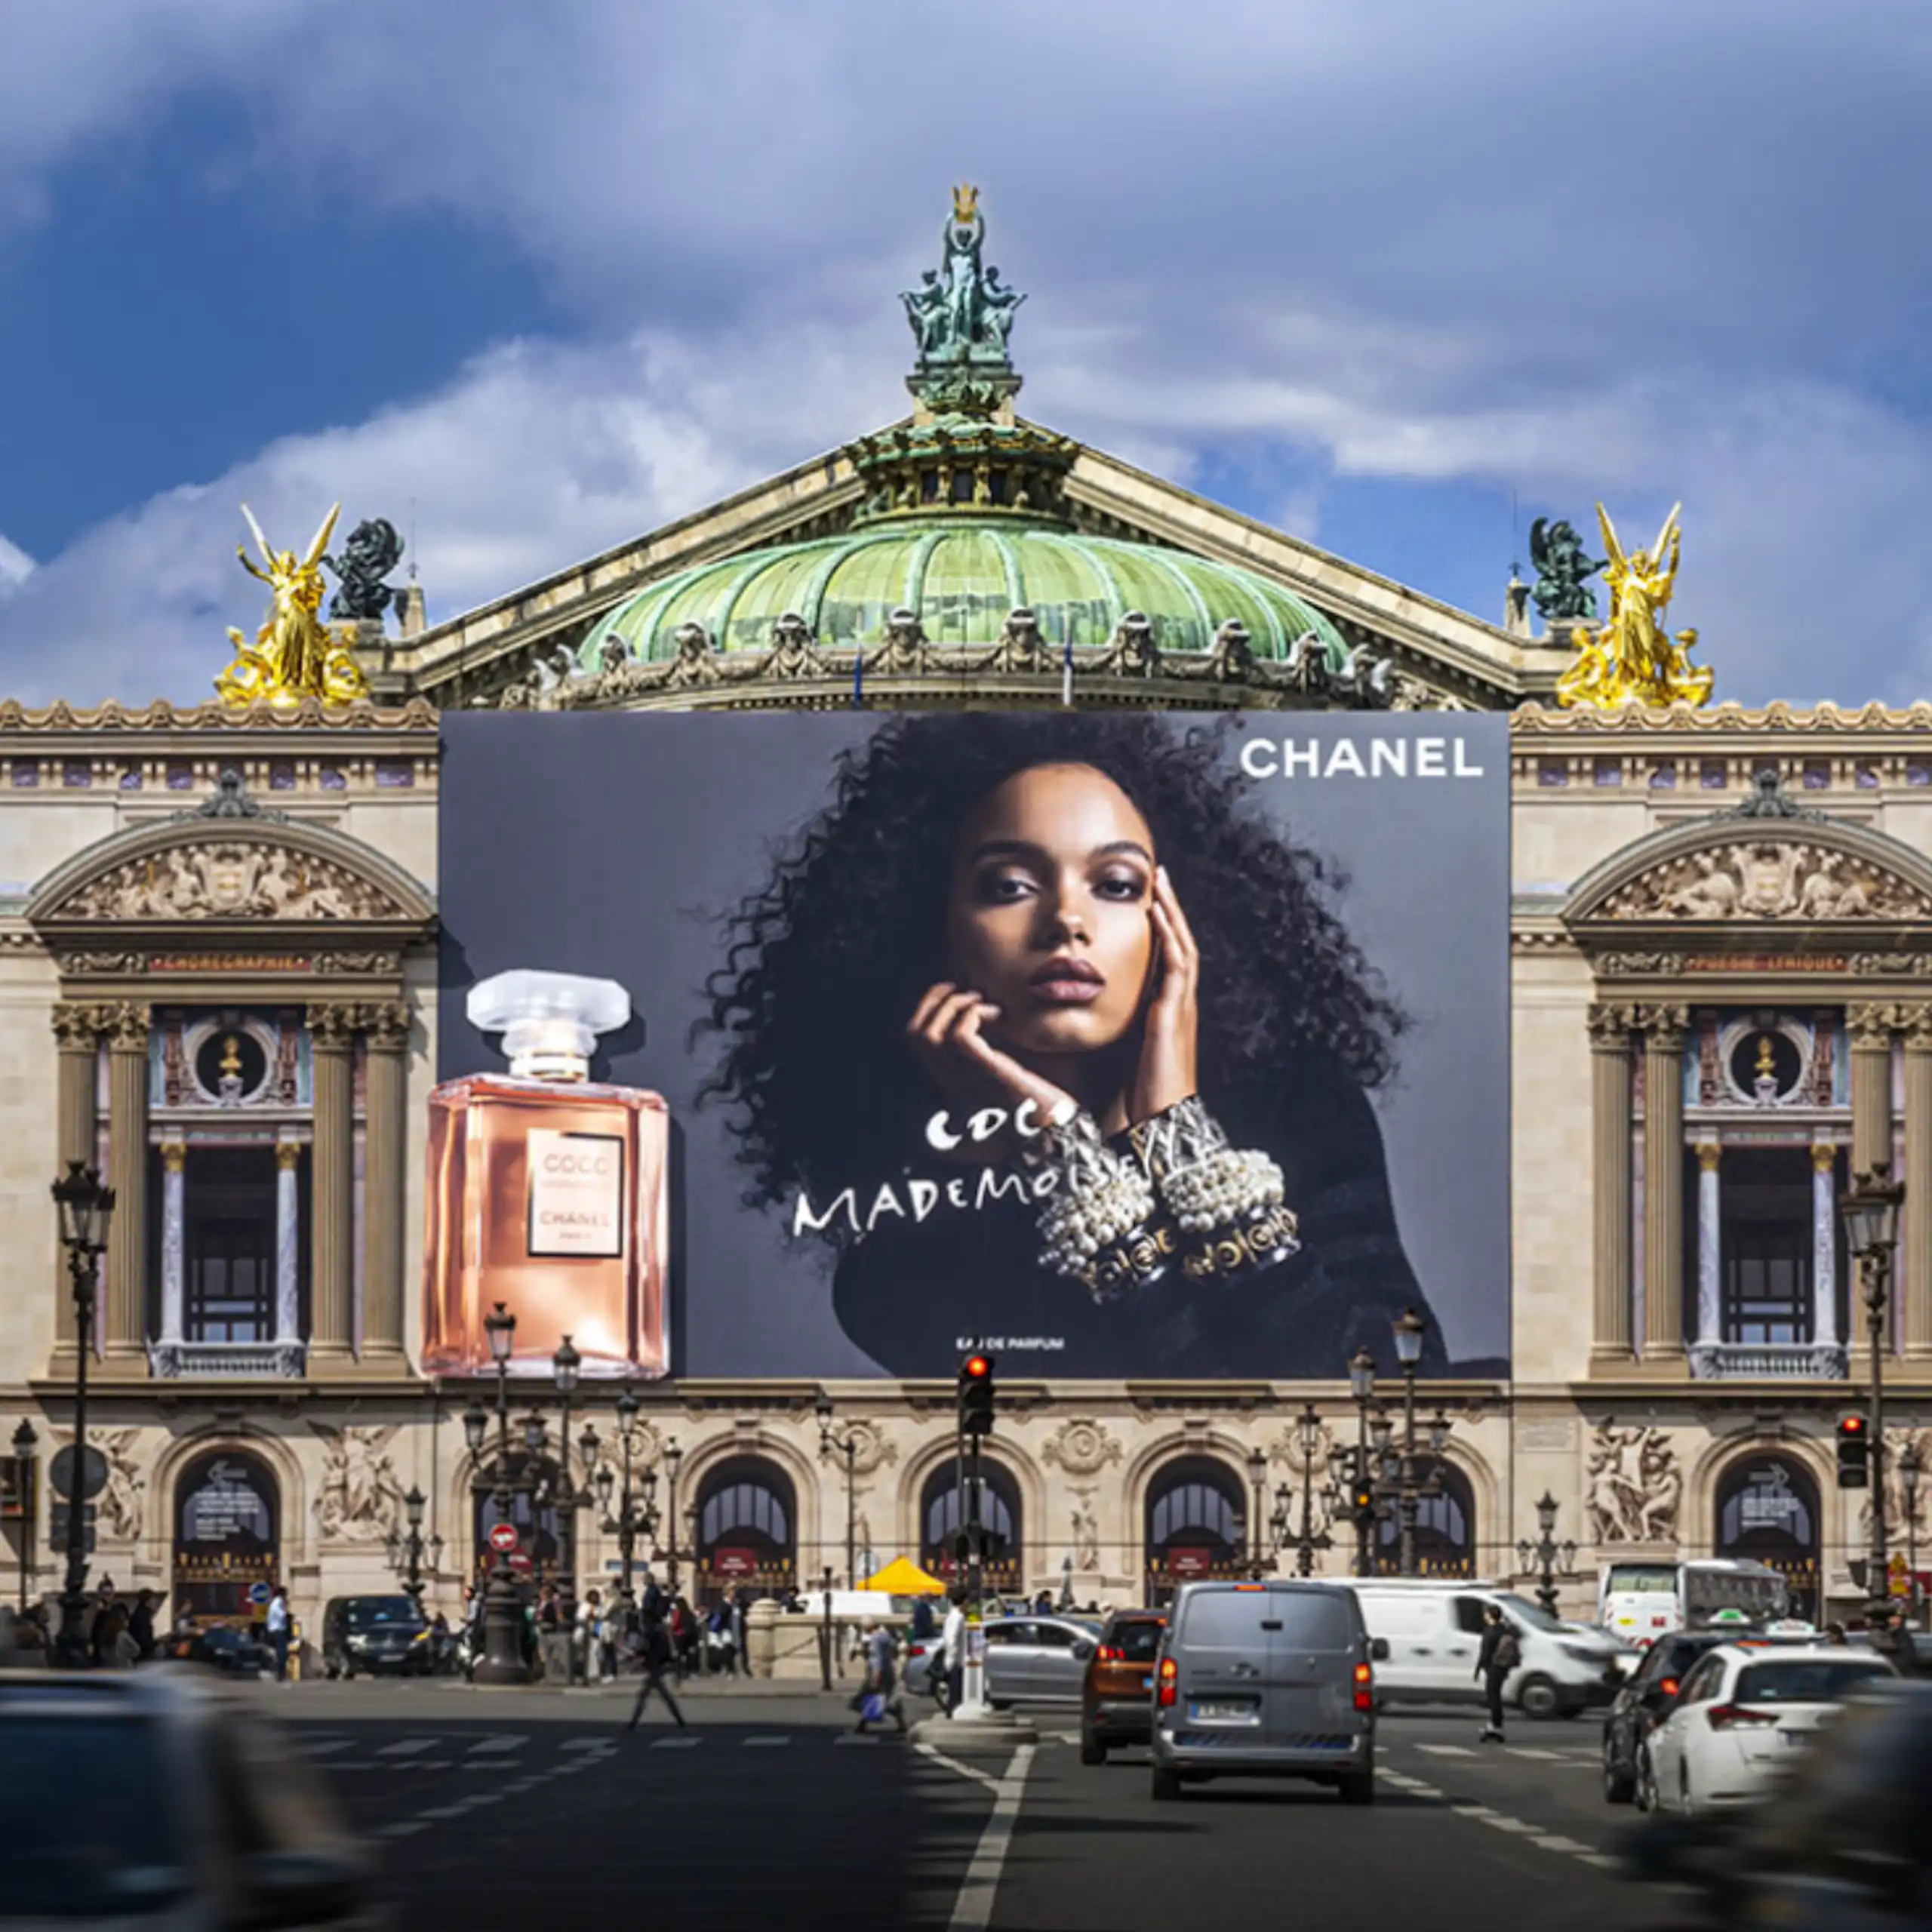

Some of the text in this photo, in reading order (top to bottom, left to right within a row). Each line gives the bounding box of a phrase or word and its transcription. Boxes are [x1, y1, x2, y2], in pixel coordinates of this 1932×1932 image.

[1240, 738, 1484, 778] CHANEL
[925, 1098, 1075, 1150] COCO
[543, 1154, 608, 1175] COCO
[987, 1337, 1005, 1349] DE
[1008, 1337, 1065, 1350] PARFUM
